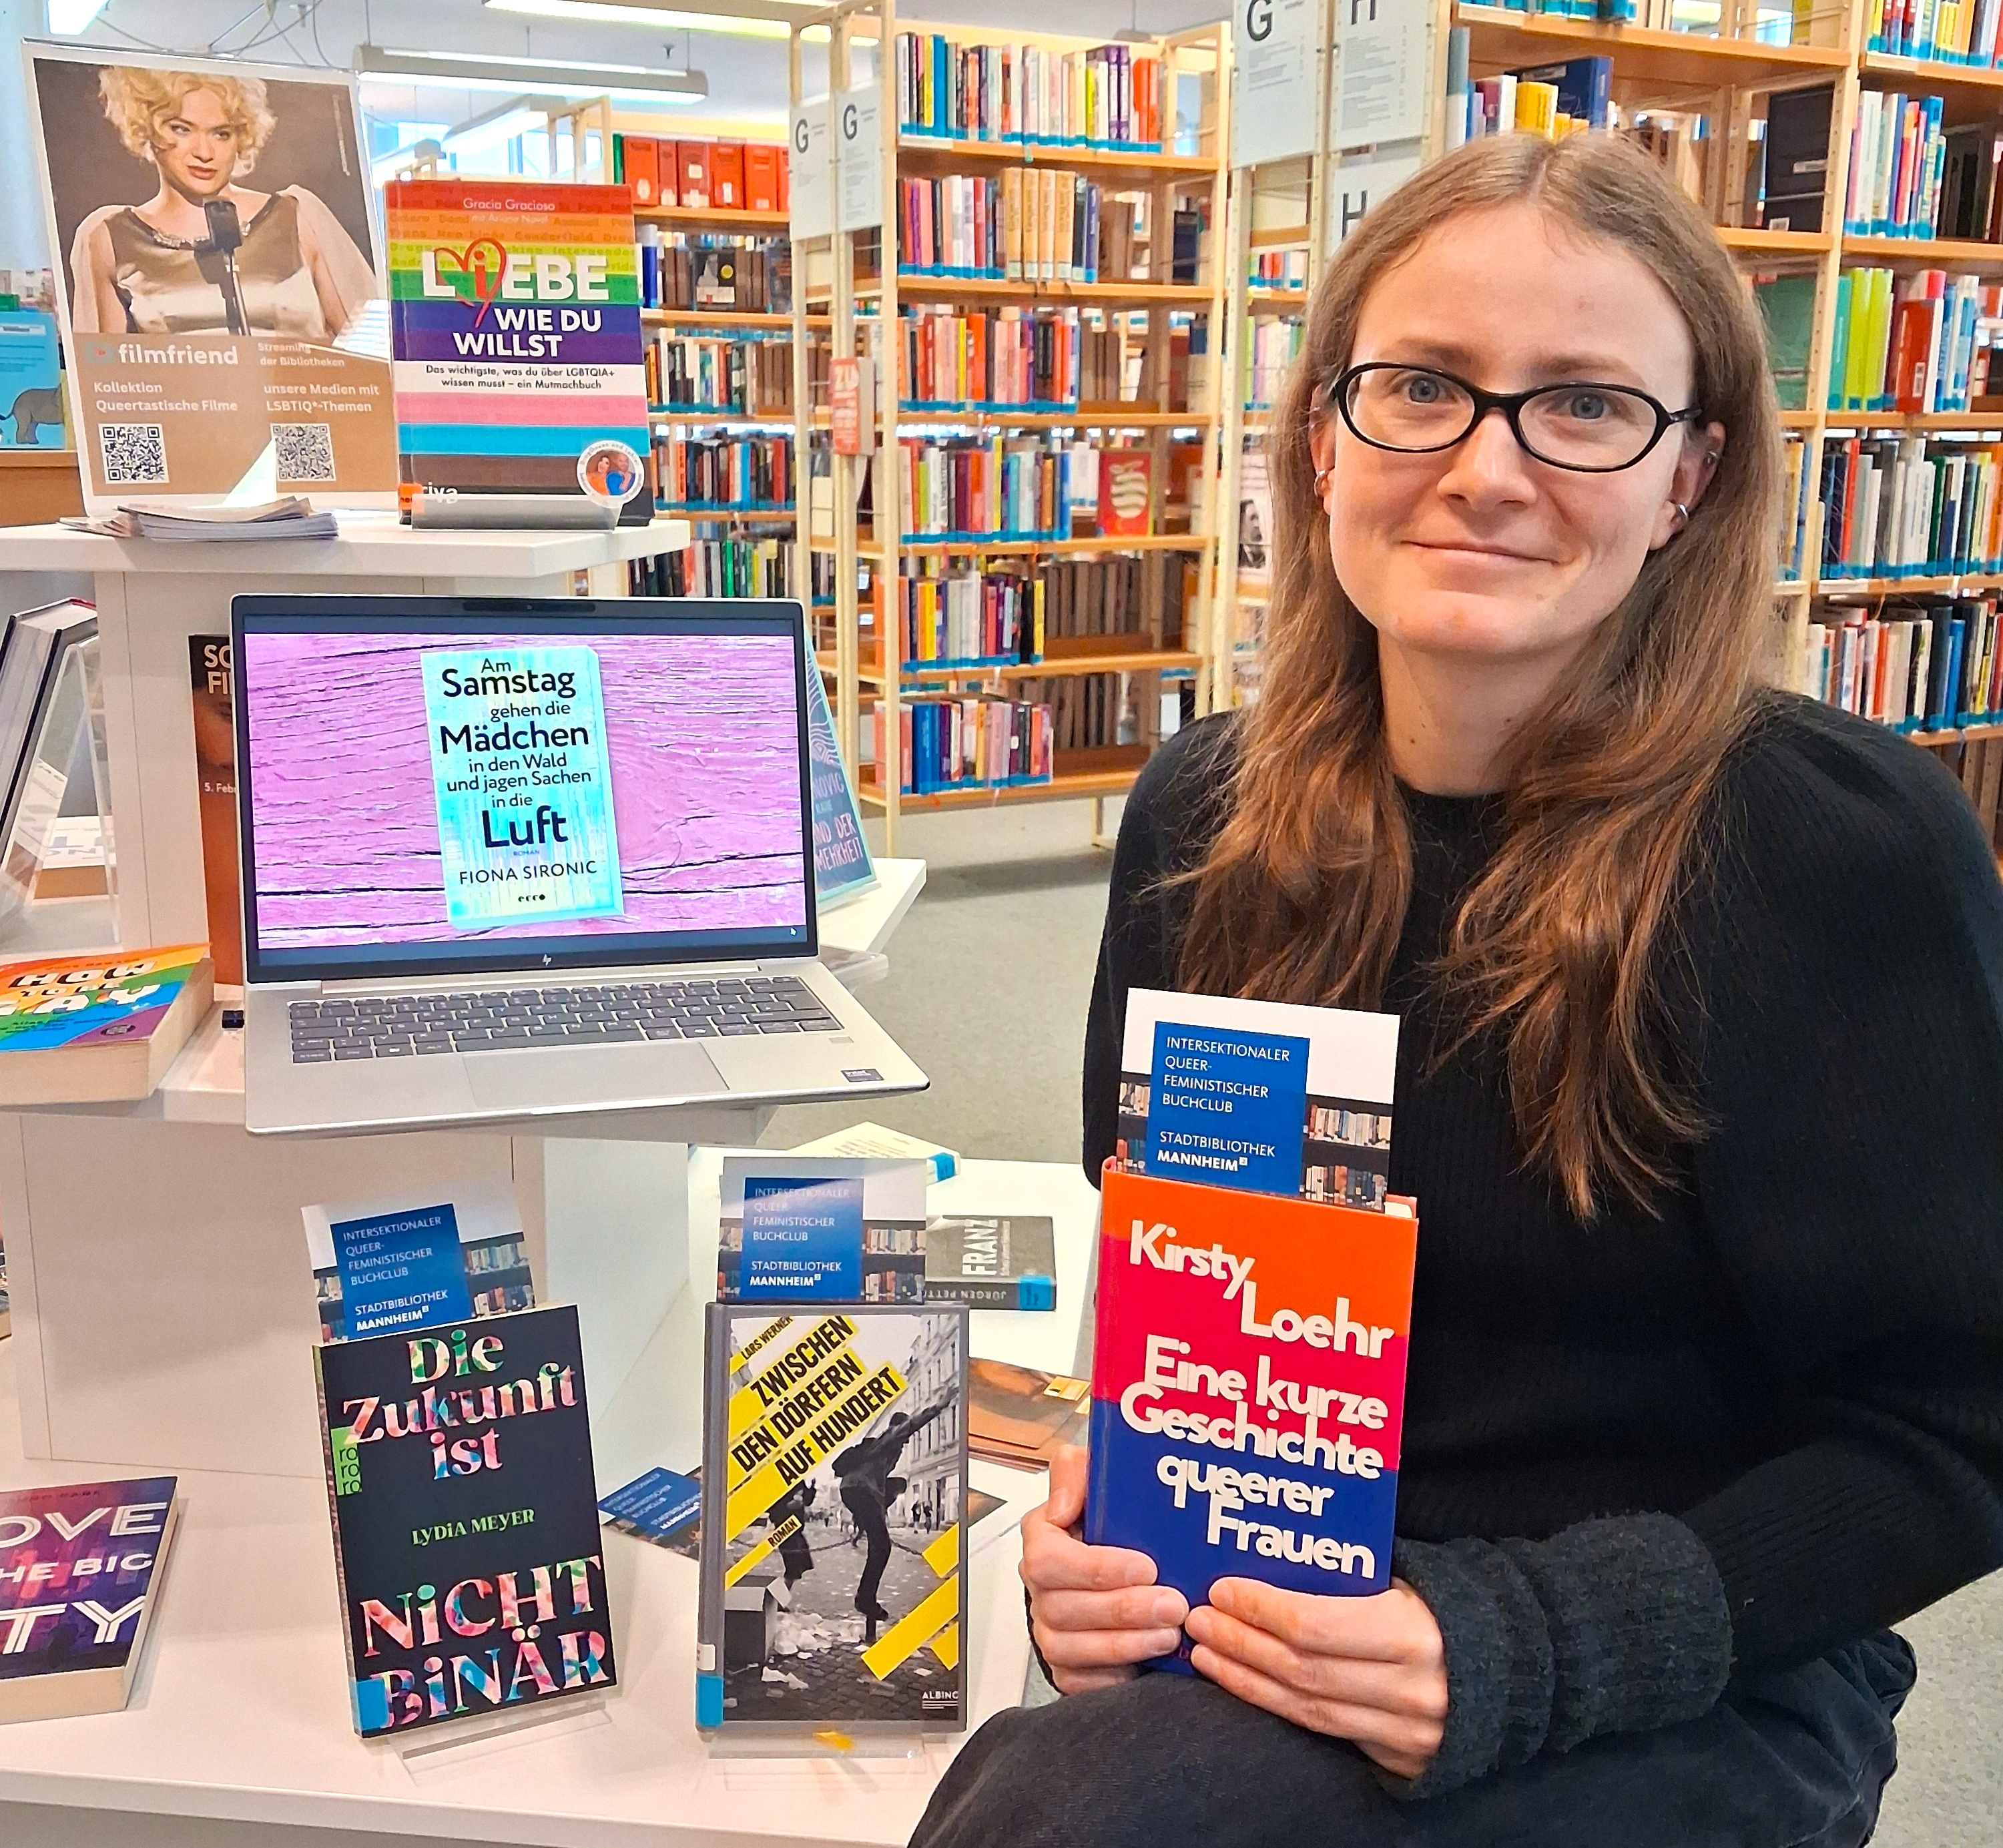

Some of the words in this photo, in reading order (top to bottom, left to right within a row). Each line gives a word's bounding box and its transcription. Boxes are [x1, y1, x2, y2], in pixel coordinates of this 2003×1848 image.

[1247, 0, 1273, 41] G
[843, 104, 858, 139] G
[796, 118, 809, 153] G
[463, 198, 501, 210] Gracia
[505, 199, 555, 212] Gracioso
[495, 308, 553, 332] WIE
[561, 310, 601, 332] DU
[118, 344, 238, 365] filmfriend
[453, 333, 563, 357] WILLST
[260, 358, 276, 366] der
[280, 357, 344, 367] Bibliotheken
[426, 365, 445, 374] Das
[448, 366, 499, 376] wichtigste,
[526, 367, 537, 376] du
[541, 368, 563, 377] über
[94, 382, 162, 393] Kollektion
[264, 386, 306, 395] unsere
[310, 384, 355, 395] Medien
[358, 384, 379, 395] mit
[441, 378, 474, 388] wissen
[478, 379, 505, 388] musst
[517, 380, 532, 388] ein
[535, 379, 601, 389] Mutmachbuch
[96, 400, 198, 412] Queertastische
[202, 400, 238, 411] Filme
[481, 658, 511, 673] Am
[442, 668, 577, 699] Samstag
[491, 703, 541, 723] gehen
[545, 701, 571, 715] die
[441, 720, 589, 754] Mädchen
[469, 758, 484, 773] in
[488, 757, 520, 772] den
[522, 752, 567, 769] Wald
[447, 776, 479, 792] und
[483, 775, 528, 794] jagen
[531, 770, 591, 787] Sachen
[491, 795, 505, 808] in
[509, 793, 533, 806] die
[482, 805, 569, 848] Luft
[835, 812, 856, 838] DER
[816, 837, 864, 872] MEHRHEIT
[459, 868, 518, 885] FIONA
[523, 861, 597, 879] SIRONIC
[12, 962, 156, 988] HOW
[1167, 1037, 1290, 1061] INTERSEKTIONALER
[1165, 1056, 1212, 1071] QUEER-
[1164, 1074, 1268, 1098] FEMINISTISCHER
[1162, 1093, 1233, 1113] BUCHCLUB
[1160, 1131, 1275, 1157] STADTBIBLIOTHEK
[344, 1216, 441, 1241] INTERSEKTIONALER
[754, 1217, 834, 1226] FEMINISTISCHER
[753, 1231, 808, 1241] BUCHCLUB
[962, 1219, 998, 1275] FRANZ
[346, 1243, 384, 1256] QUEER-
[348, 1247, 433, 1270] FEMINISTISCHER
[1129, 1219, 1255, 1299] Kirsty
[351, 1267, 408, 1285] BUCHCLUB
[752, 1261, 842, 1271] STADTBIBLIOTHEK
[355, 1289, 449, 1315] STADTBIBLIOTHEK
[1241, 1281, 1394, 1358] Loehr
[406, 1329, 505, 1384] Die
[741, 1339, 762, 1360] LARS
[750, 1315, 854, 1409] ZWISCHEN
[1145, 1334, 1247, 1401] Eine
[1256, 1355, 1388, 1430] kurze
[342, 1362, 577, 1445] Zukunft
[731, 1424, 780, 1472] DEN
[770, 1353, 863, 1440] DÖRFERN
[774, 1439, 816, 1486] AUF
[810, 1366, 900, 1454] HUNDERT
[1120, 1382, 1384, 1479] Geschichte
[340, 1448, 357, 1462] ro
[429, 1427, 503, 1481] ist
[341, 1464, 359, 1478] ro
[343, 1480, 361, 1494] ro
[1157, 1454, 1334, 1516] queerer
[471, 1509, 535, 1533] MEYER
[768, 1518, 798, 1547] ROMAN
[1207, 1490, 1375, 1579] Frauen
[72, 1553, 153, 1576] BIG
